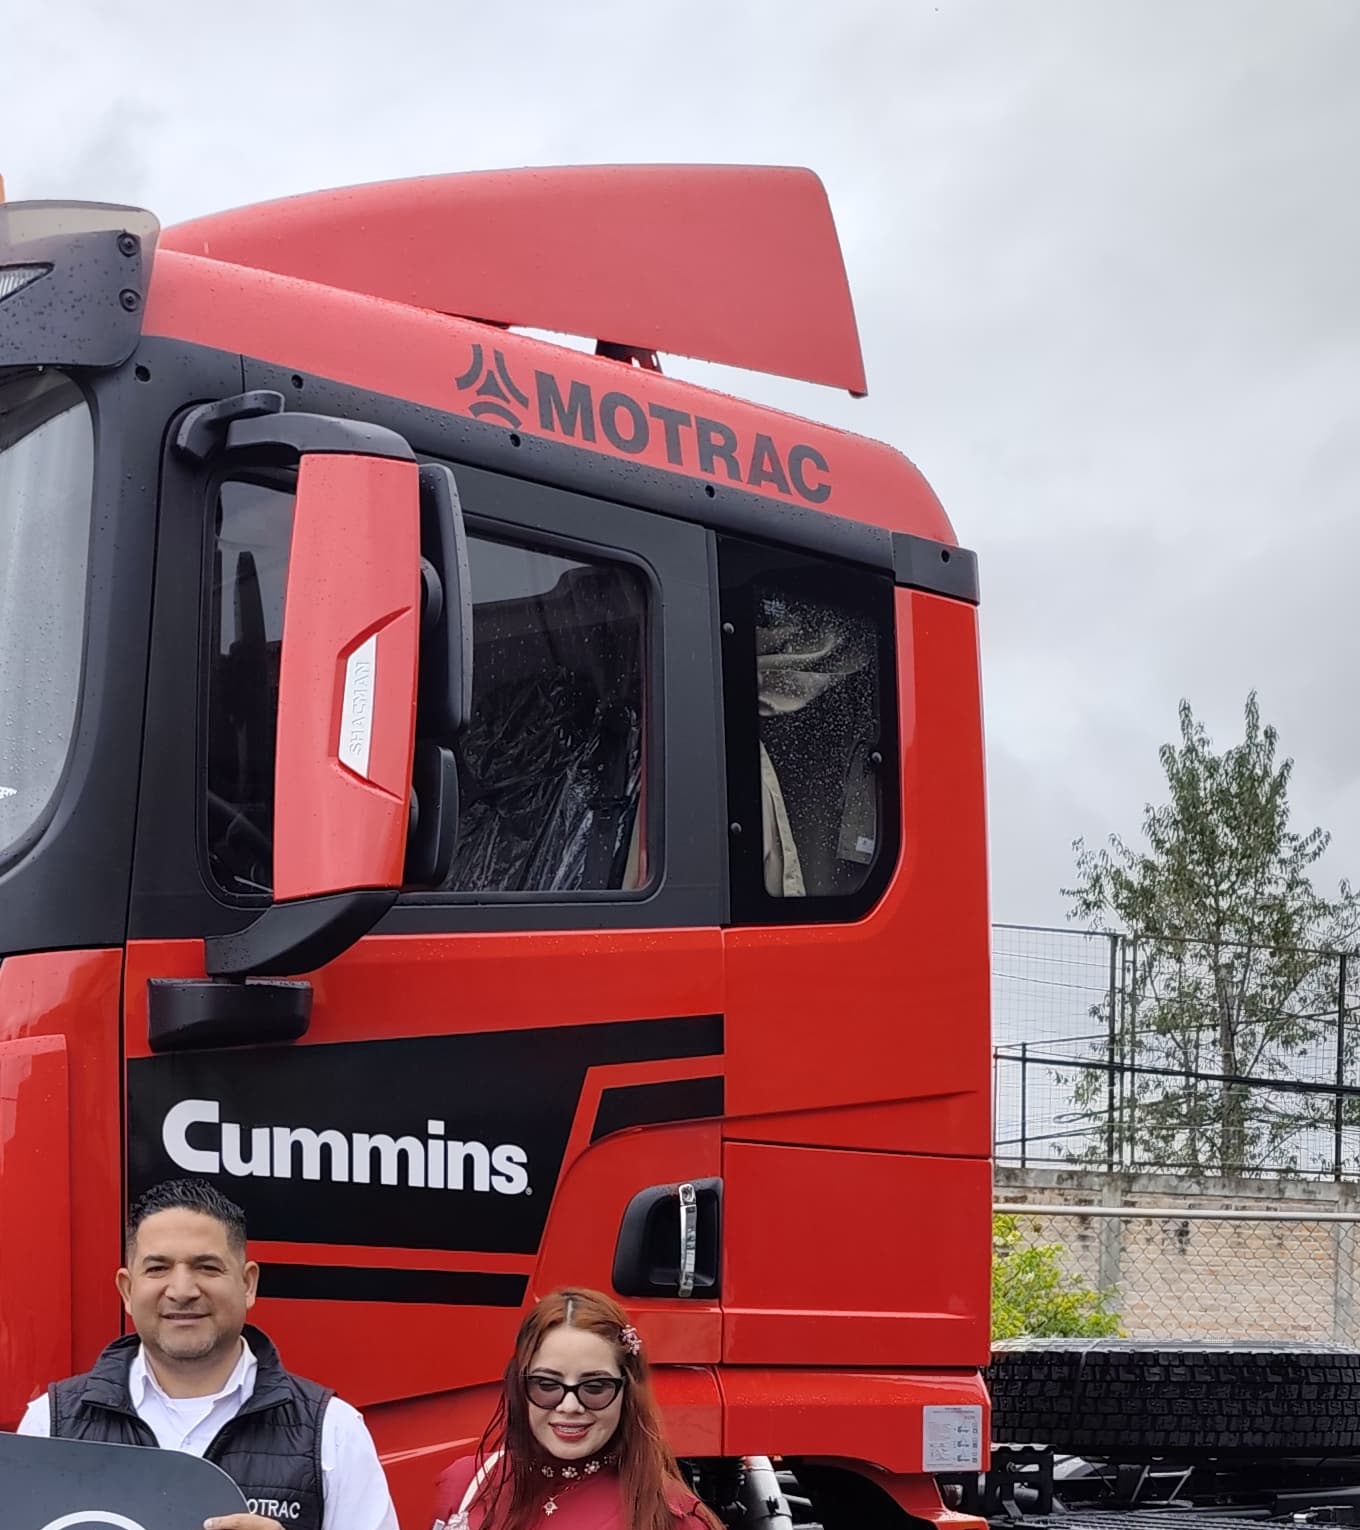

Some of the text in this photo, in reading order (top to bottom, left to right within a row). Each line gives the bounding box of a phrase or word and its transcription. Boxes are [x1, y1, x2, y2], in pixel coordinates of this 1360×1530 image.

[535, 370, 832, 504] MOTRAC
[349, 662, 370, 755] SHACMAN
[162, 1099, 529, 1195] Cummins
[247, 1498, 301, 1519] OTRAC
